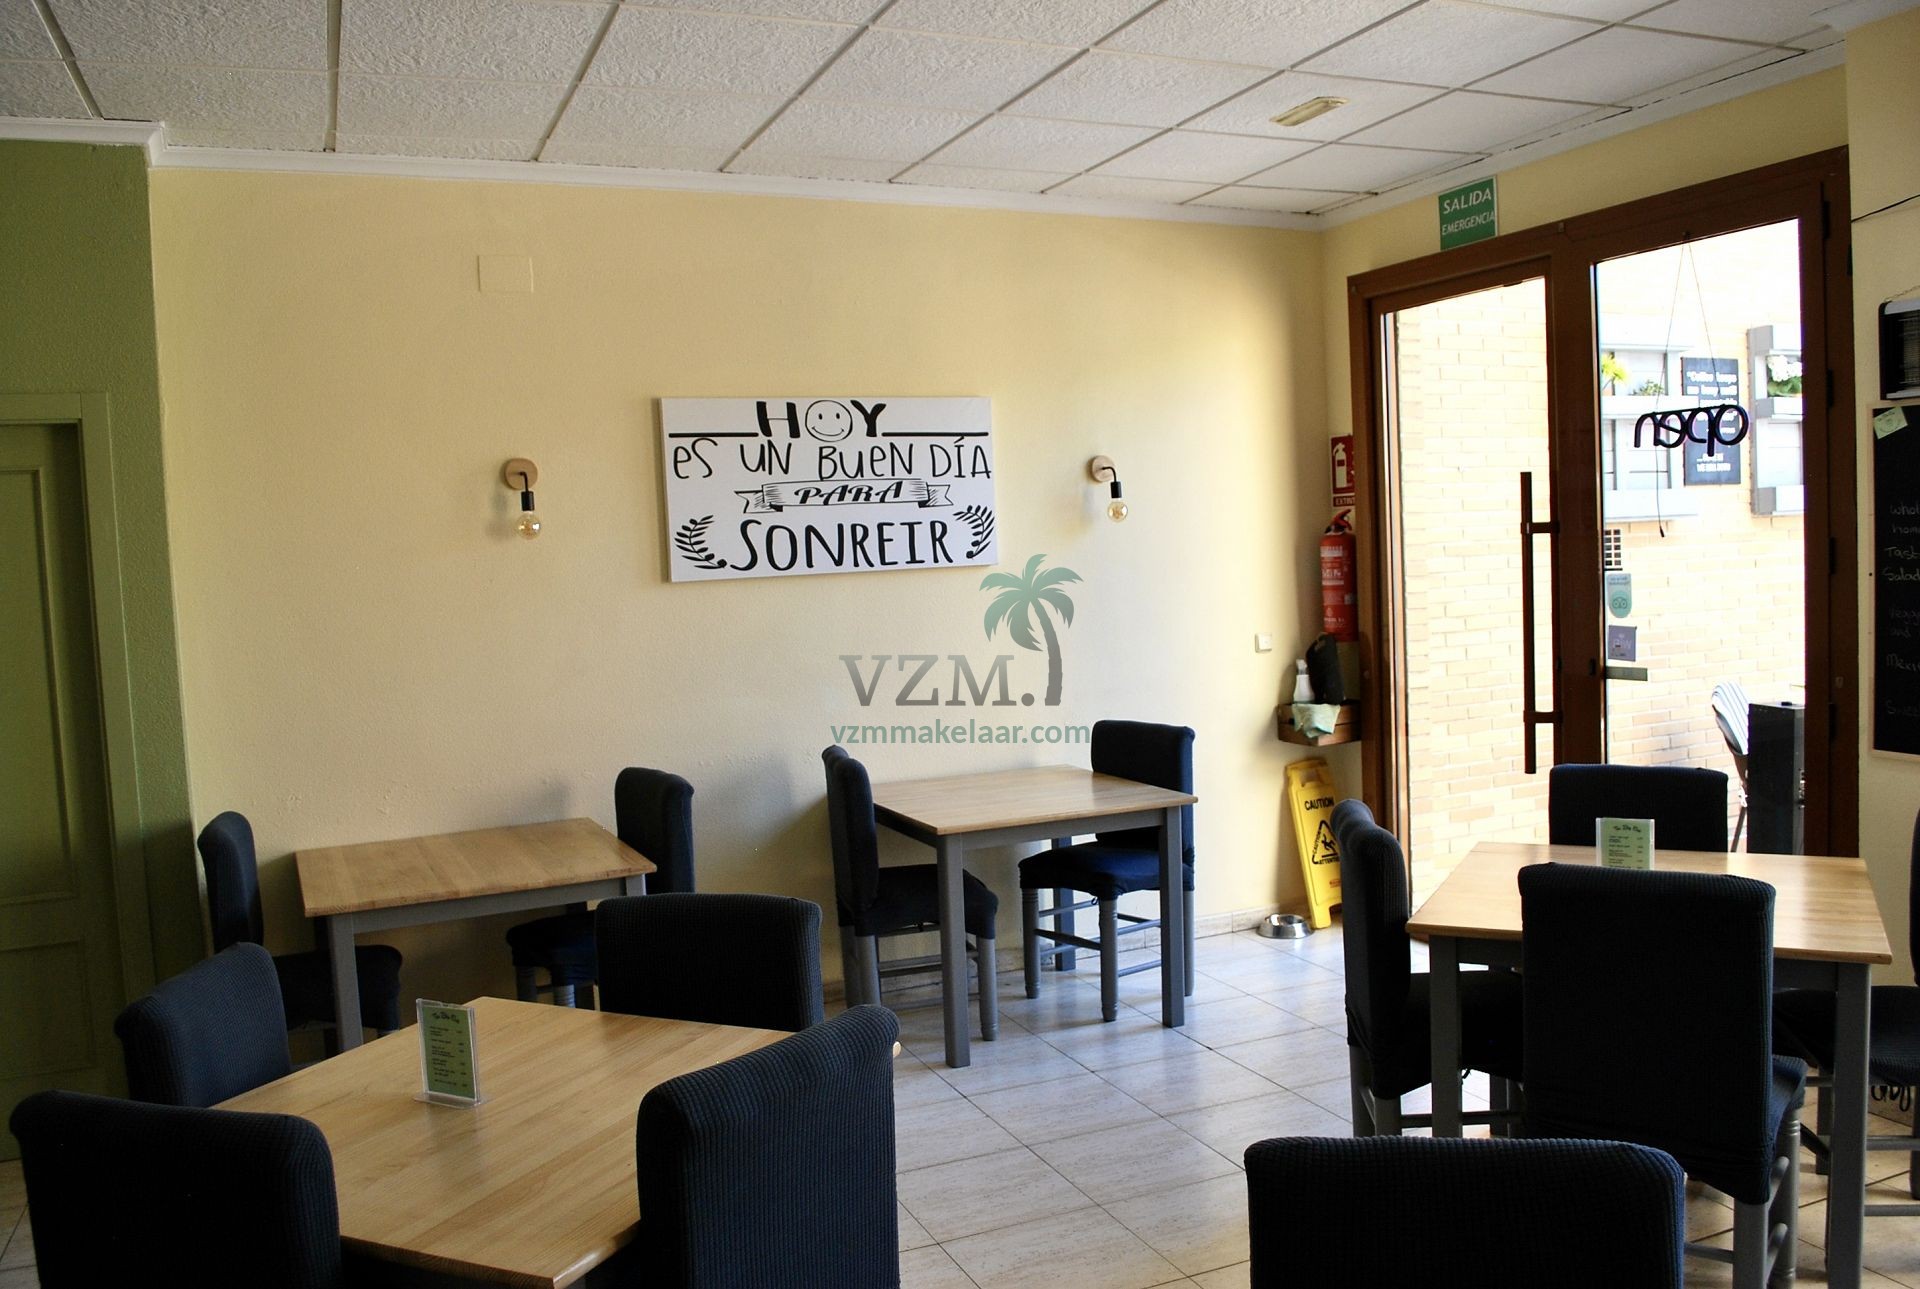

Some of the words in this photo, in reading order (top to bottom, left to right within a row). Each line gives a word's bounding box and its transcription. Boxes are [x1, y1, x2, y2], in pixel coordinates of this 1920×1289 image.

[1443, 188, 1492, 215] SALIDA
[1441, 210, 1495, 236] EMERGENCIA
[756, 399, 887, 442] HOY
[930, 436, 992, 479] DÍA
[794, 481, 903, 506] PARA
[730, 519, 953, 571] SONREIR
[1304, 796, 1335, 811] CAUTION
